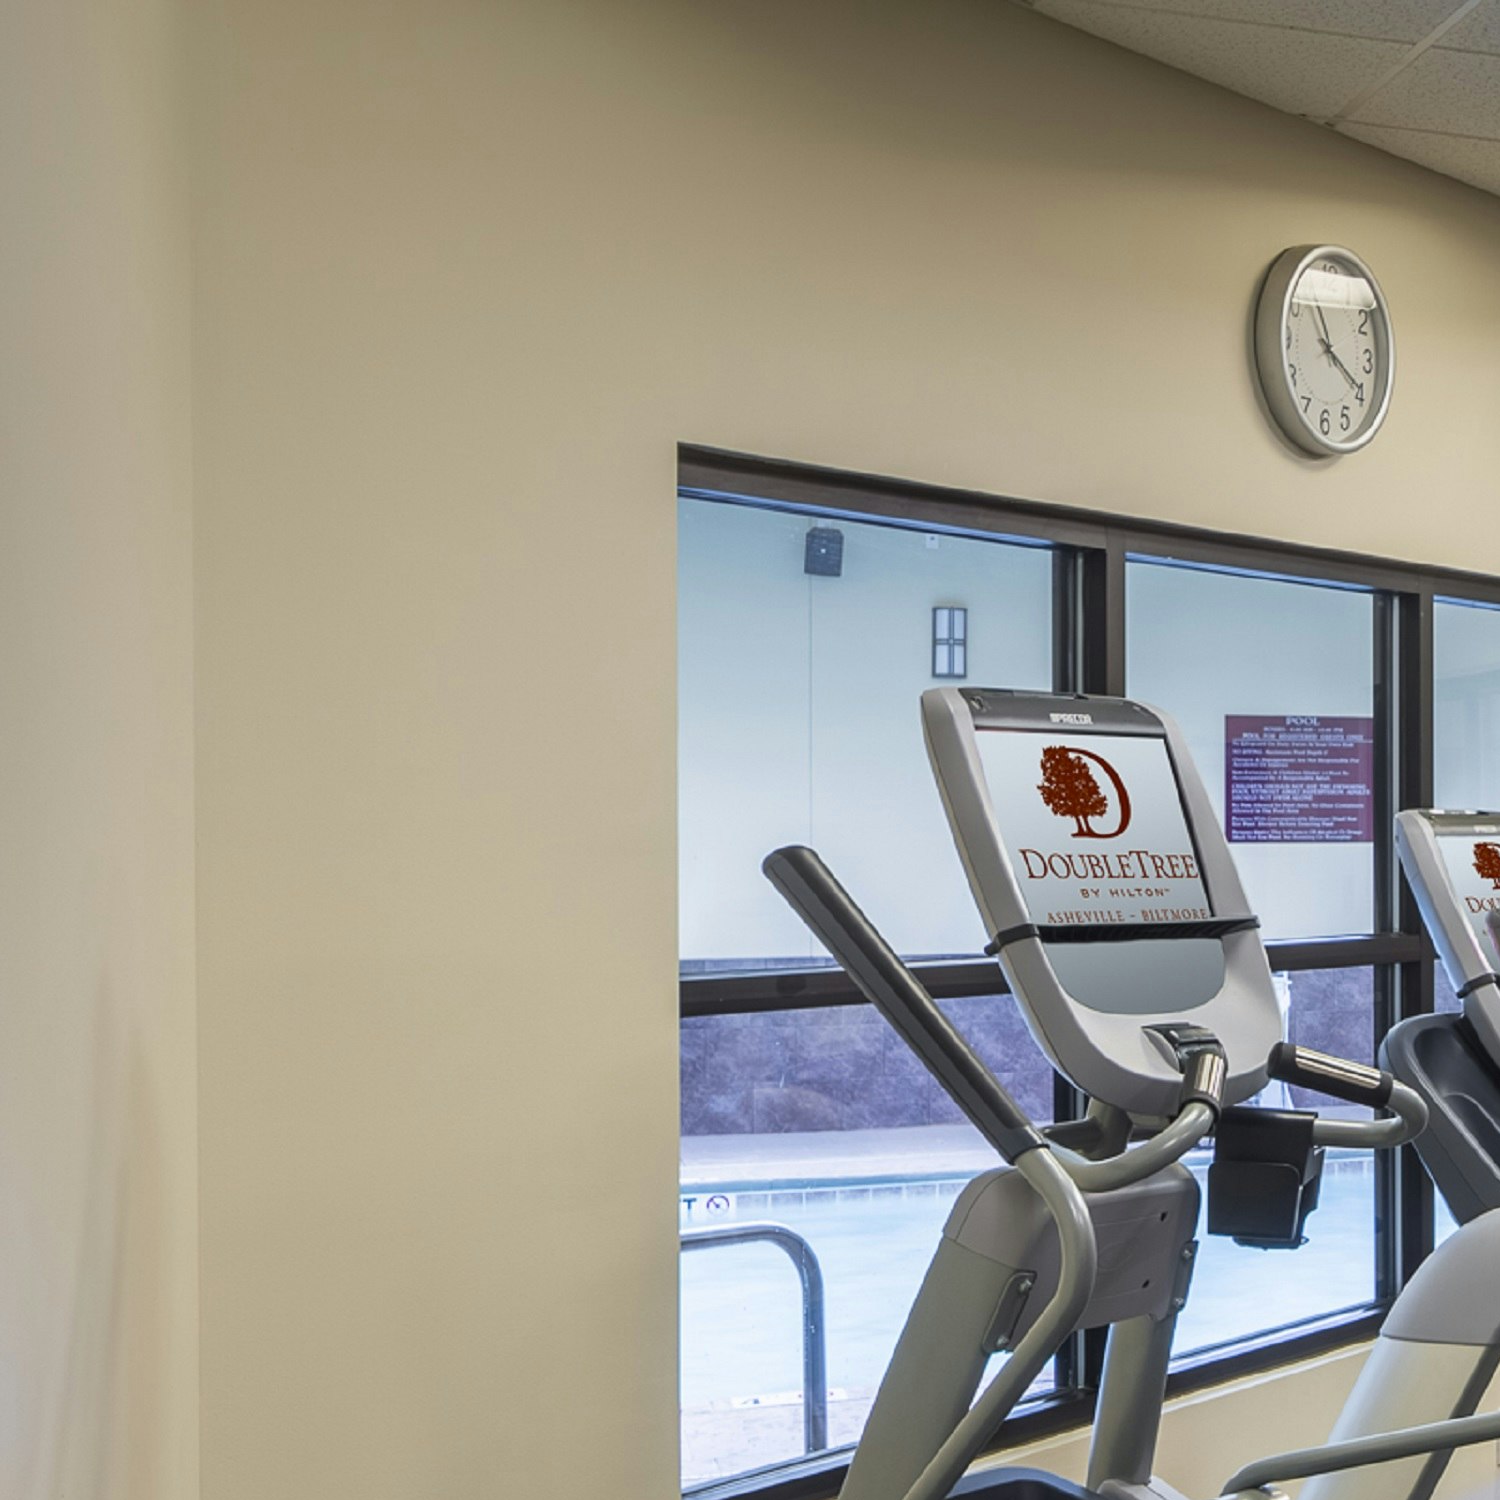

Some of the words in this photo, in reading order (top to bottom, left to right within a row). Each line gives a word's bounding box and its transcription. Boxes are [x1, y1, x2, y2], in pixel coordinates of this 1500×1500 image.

[1358, 309, 1369, 336] 2
[1362, 349, 1374, 375] 3
[1300, 395, 1312, 413] 7
[1355, 382, 1365, 407] 4
[1319, 408, 1330, 436] 6
[1340, 405, 1351, 432] 5
[1285, 716, 1321, 726] POOL
[1080, 888, 1100, 898] BY
[1047, 911, 1126, 924] ASHEVILLE
[1141, 908, 1209, 922] BILTMORE
